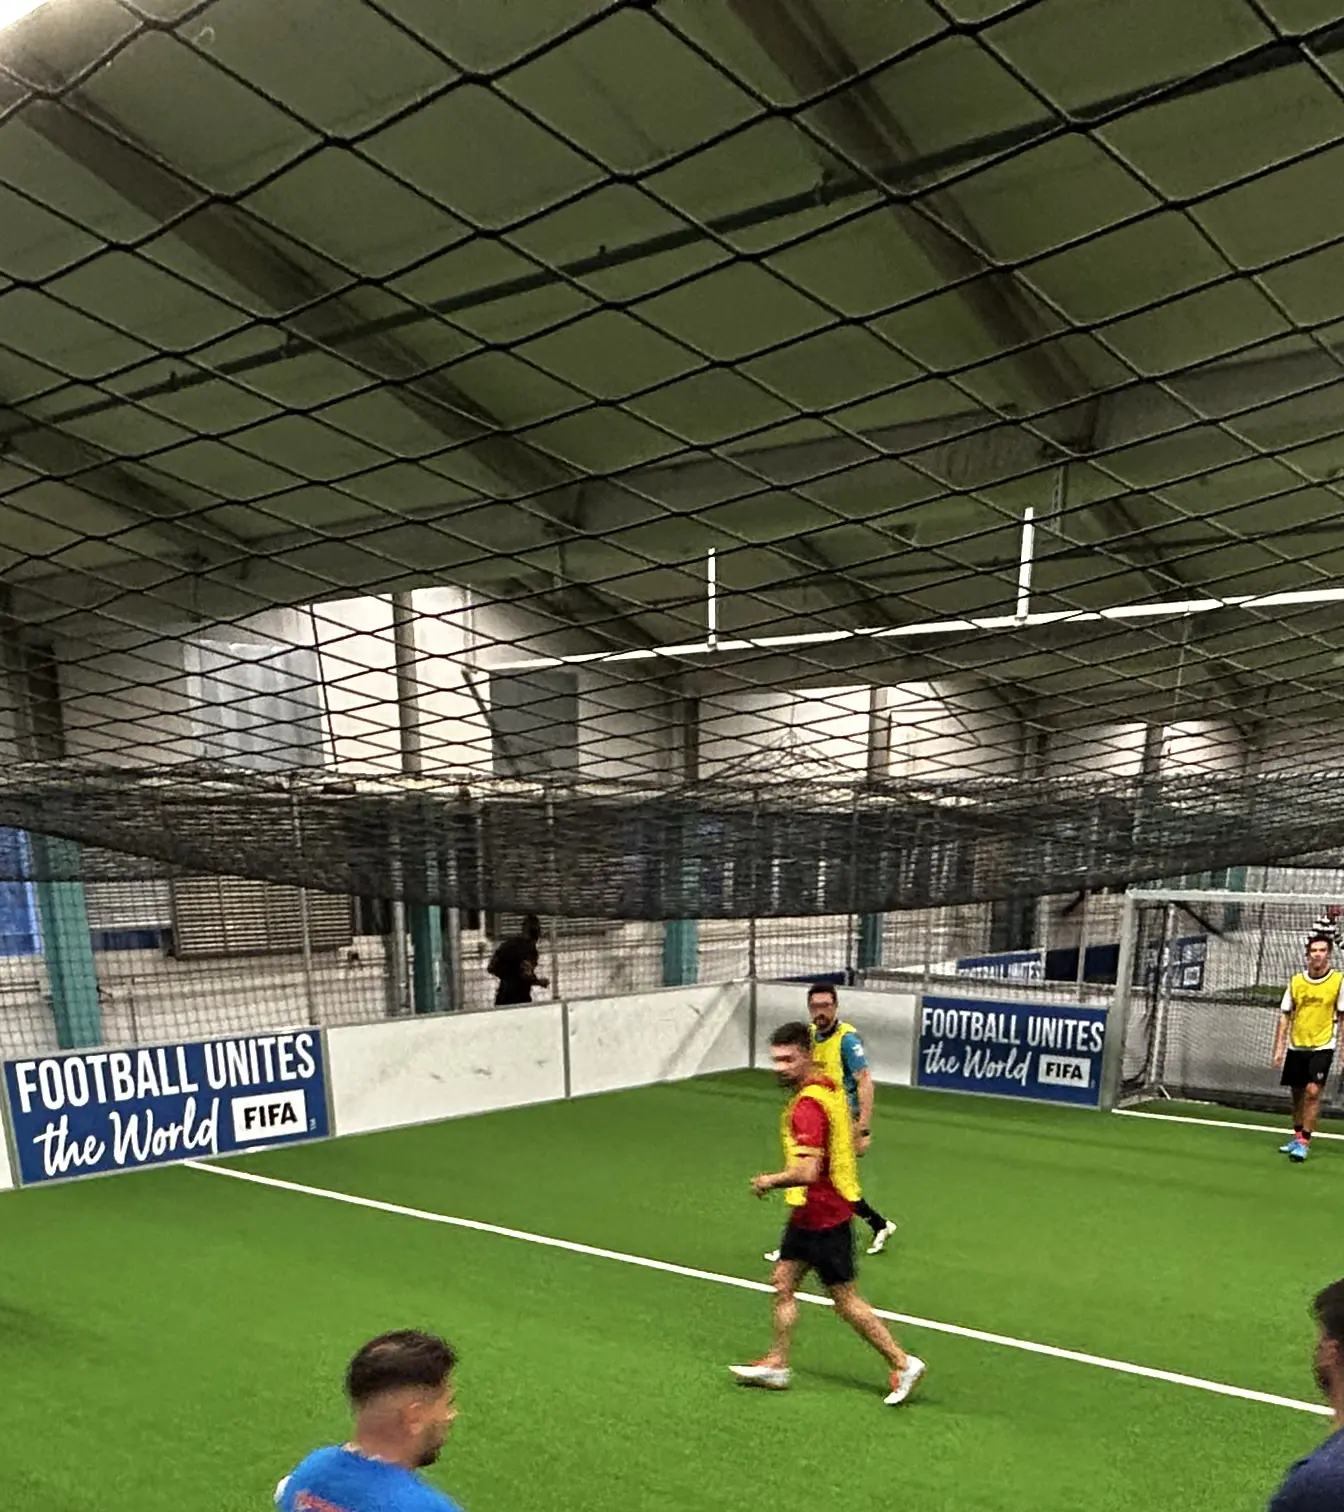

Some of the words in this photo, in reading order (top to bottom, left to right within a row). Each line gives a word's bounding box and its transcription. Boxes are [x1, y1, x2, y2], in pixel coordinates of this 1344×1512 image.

[922, 1007, 1020, 1046] FOOTBALL
[1027, 1016, 1105, 1052] UNITES
[15, 1046, 199, 1113] FOOTBALL
[204, 1033, 315, 1090] UNITES
[923, 1041, 960, 1074] the
[963, 1045, 1032, 1087] World
[1045, 1062, 1083, 1079] FIFA
[33, 1121, 104, 1176] the
[109, 1097, 220, 1164] World
[244, 1101, 298, 1130] FIFA
